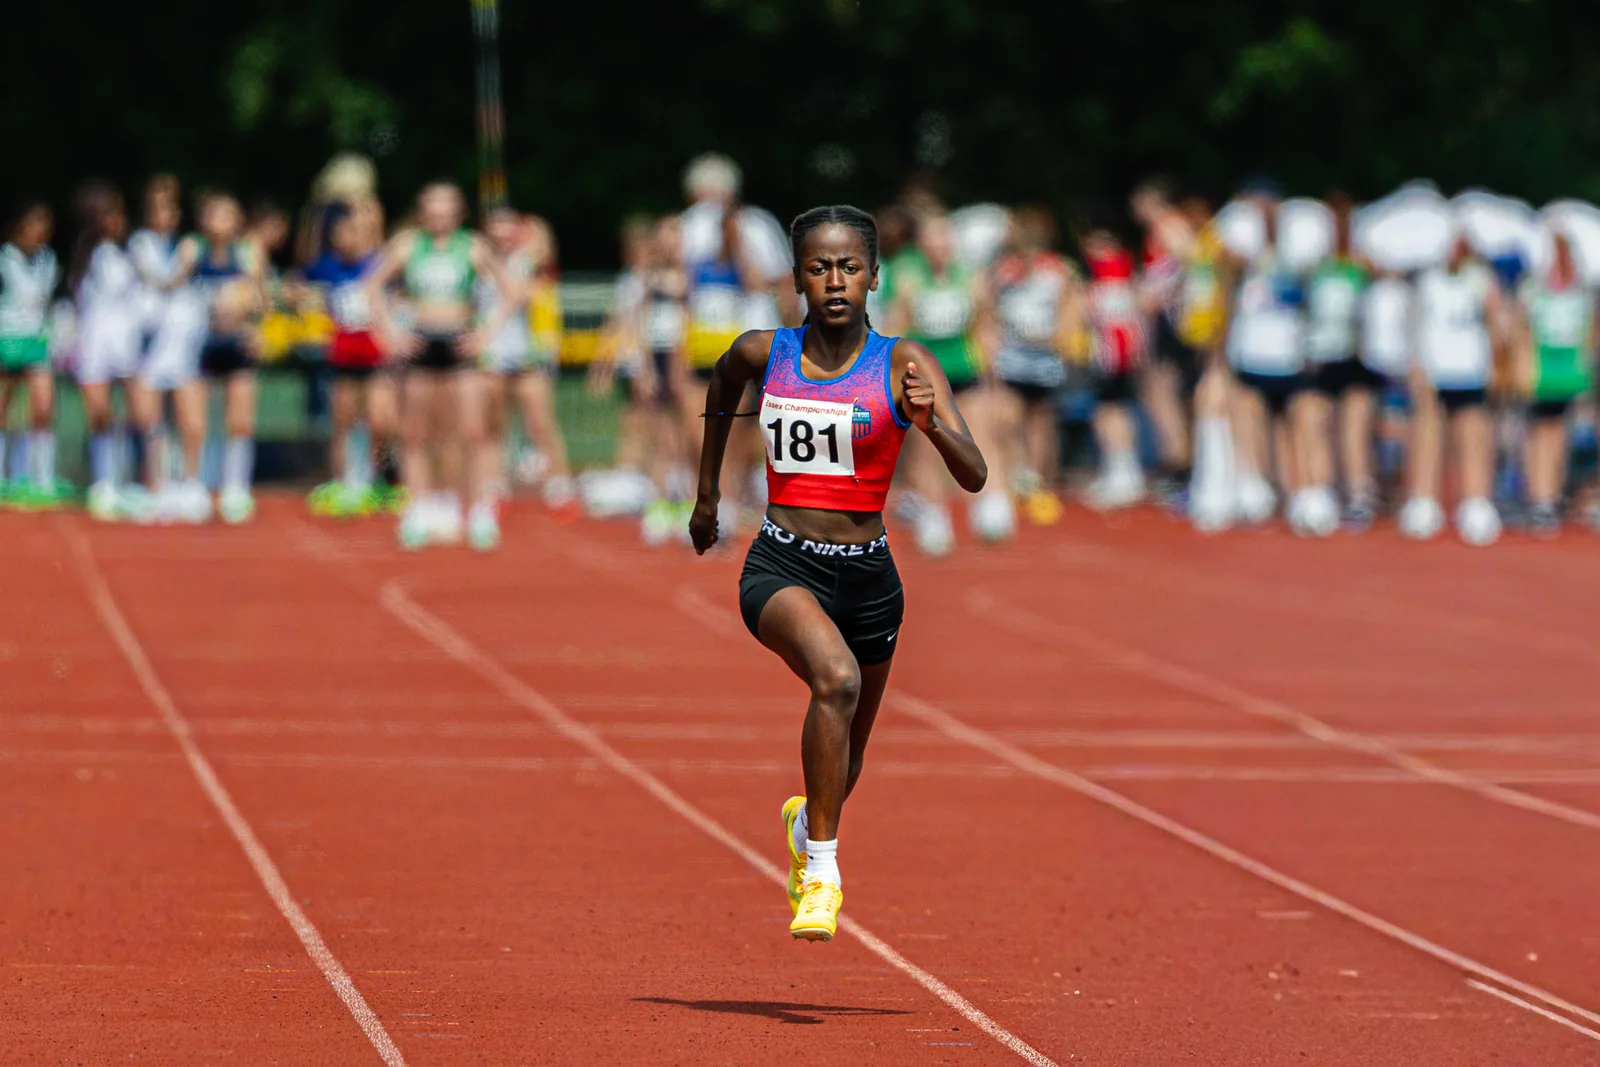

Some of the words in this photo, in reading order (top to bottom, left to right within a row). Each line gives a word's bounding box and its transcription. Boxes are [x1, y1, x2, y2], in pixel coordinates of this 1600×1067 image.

[765, 399, 783, 410] Essex
[784, 403, 848, 416] Championships
[767, 417, 839, 464] 181
[800, 539, 864, 556] NIKE
